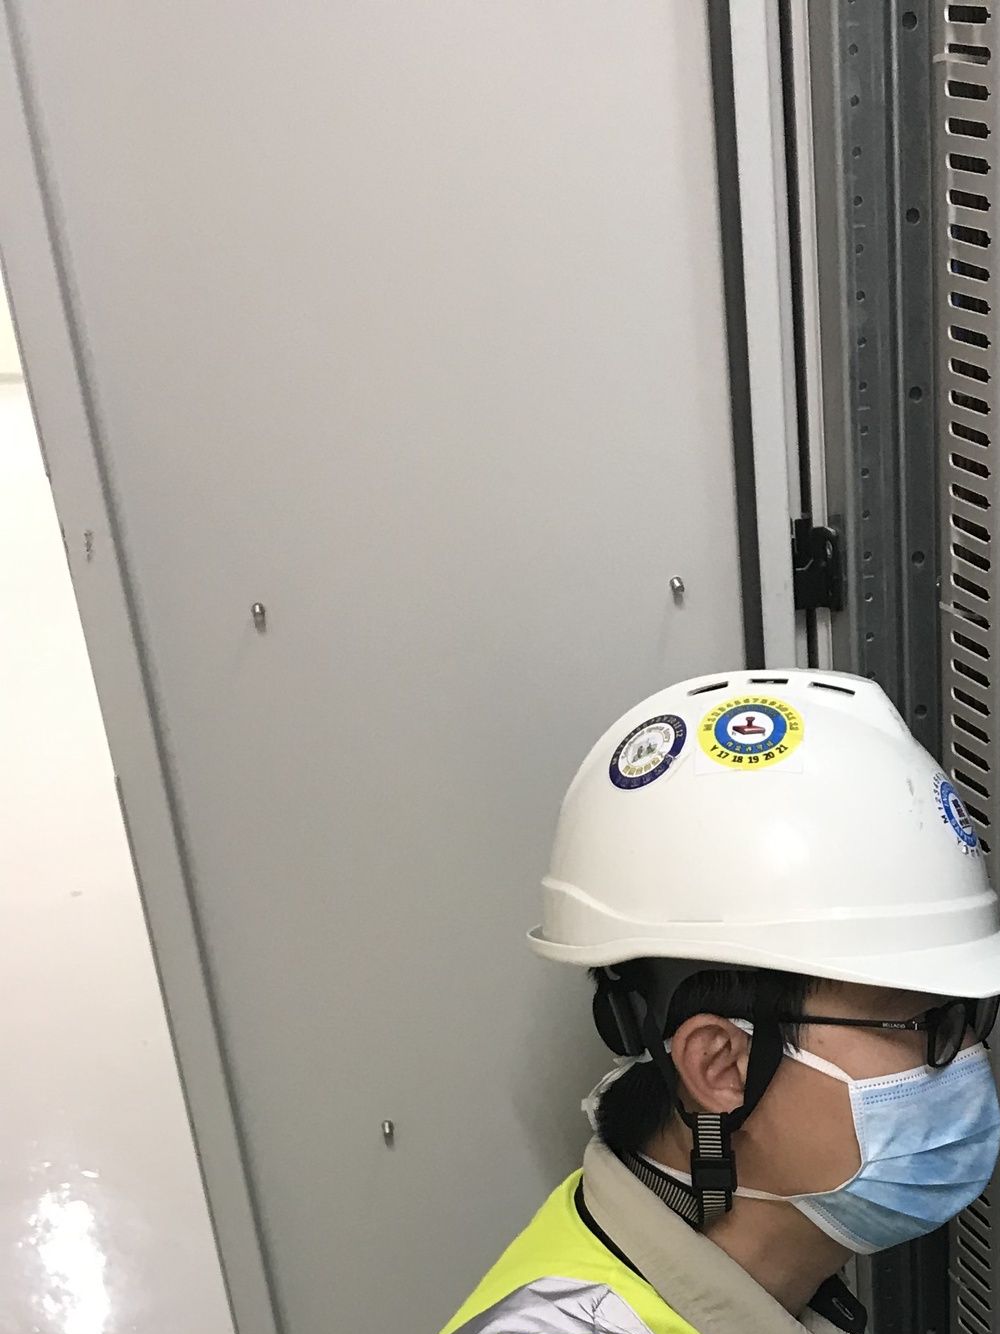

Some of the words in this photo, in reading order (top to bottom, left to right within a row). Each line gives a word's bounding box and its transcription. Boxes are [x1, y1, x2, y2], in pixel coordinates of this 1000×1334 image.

[716, 750, 730, 759] 17
[731, 756, 743, 764] 18
[748, 755, 760, 764] 19
[763, 751, 775, 761] 20
[775, 744, 789, 754] 21
